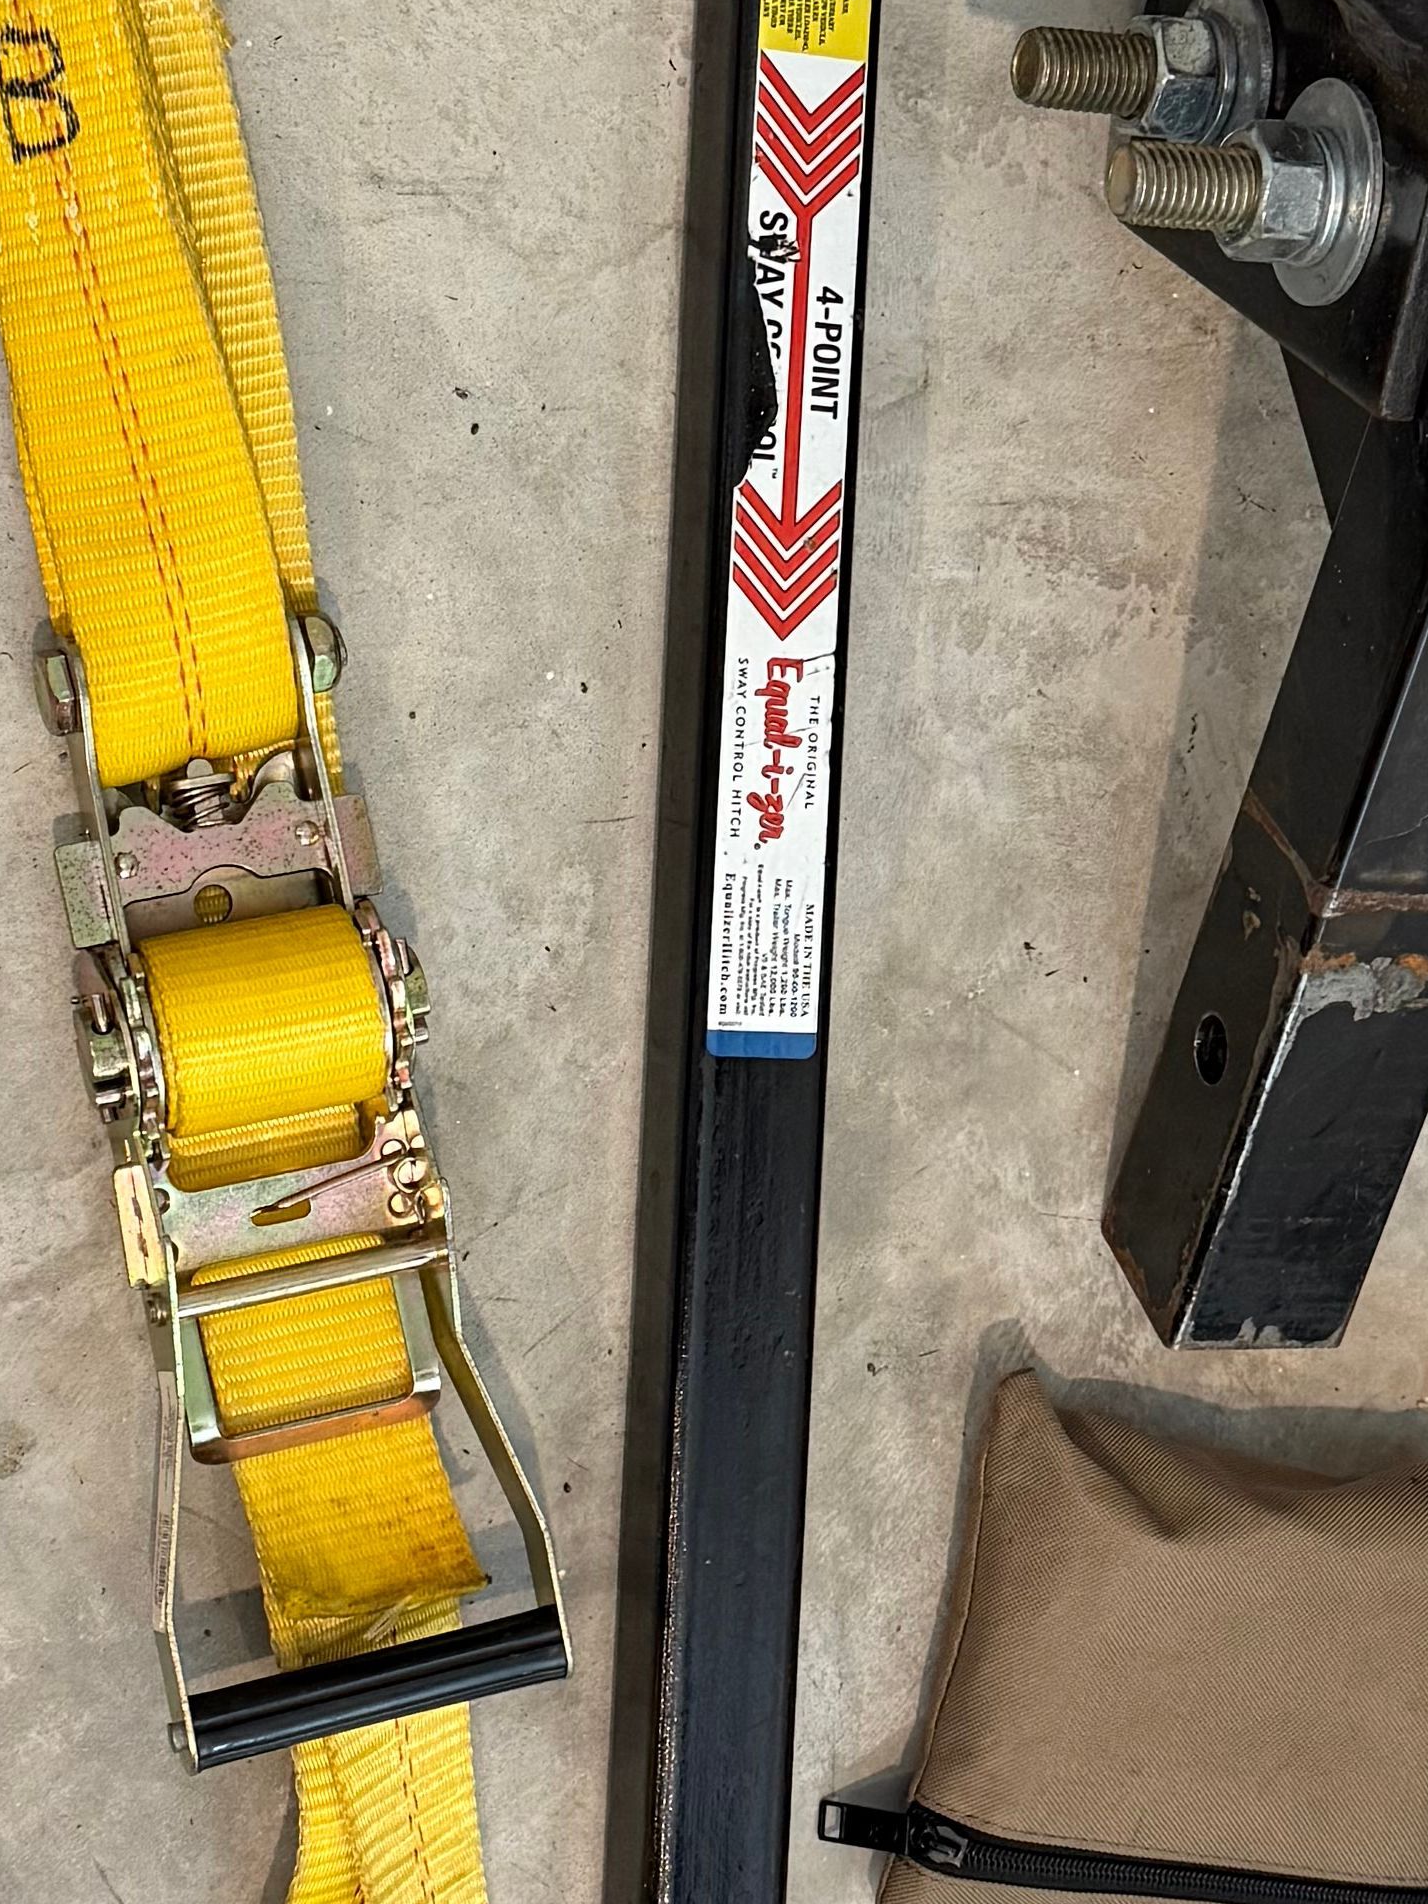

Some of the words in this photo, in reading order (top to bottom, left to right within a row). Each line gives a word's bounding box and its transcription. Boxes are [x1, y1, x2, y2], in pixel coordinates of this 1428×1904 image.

[810, 286, 843, 419] 4-POINT
[736, 657, 749, 699] SWAY
[808, 695, 820, 724] THE
[731, 705, 746, 781] CONTROL
[803, 731, 818, 809] ORIGINAL
[729, 789, 741, 837] HITCH
[804, 903, 814, 939] MADE
[803, 945, 812, 958] IN
[801, 963, 812, 988] THE
[800, 992, 810, 1017] USA
